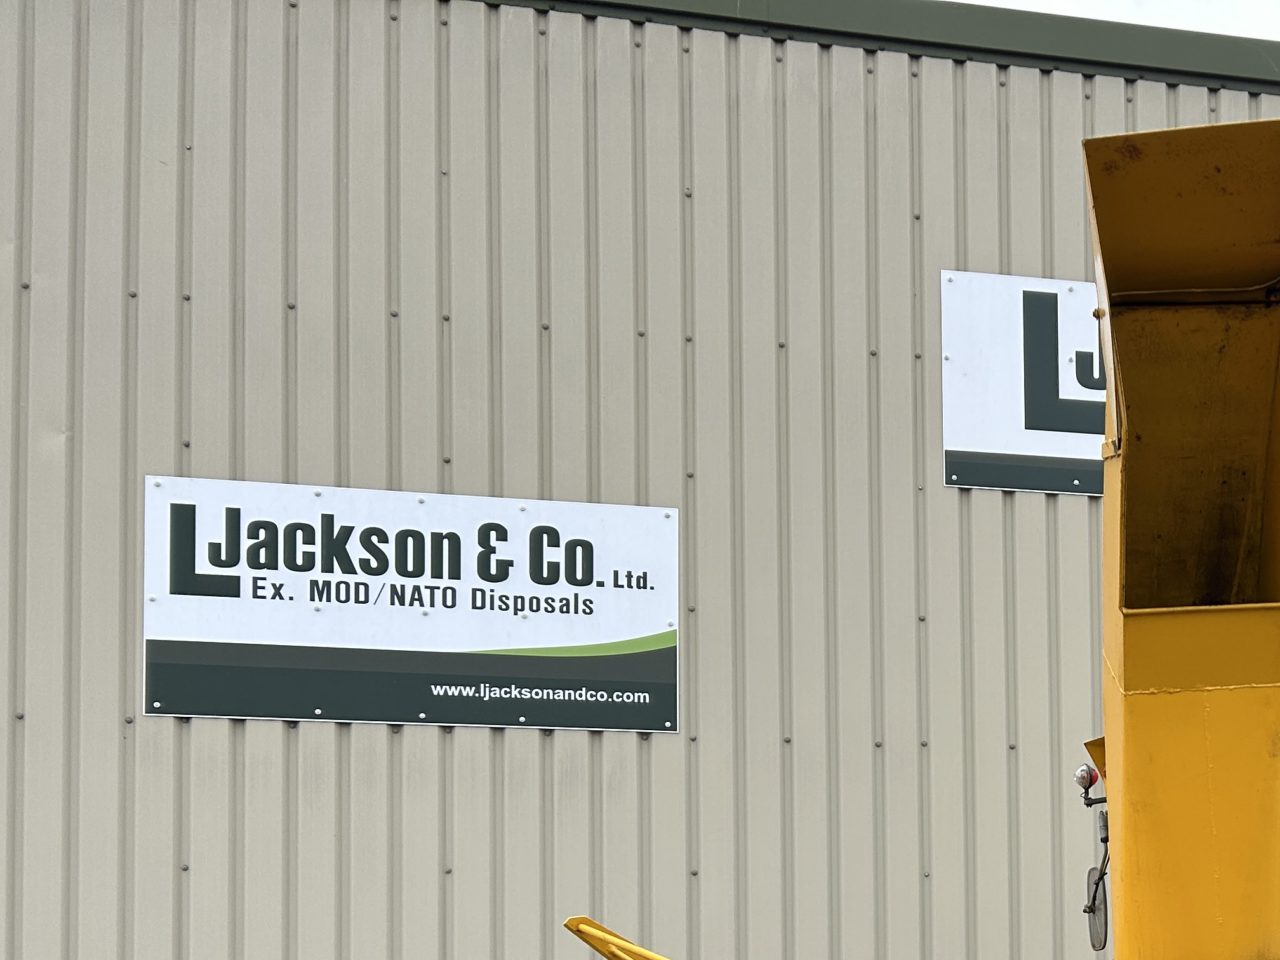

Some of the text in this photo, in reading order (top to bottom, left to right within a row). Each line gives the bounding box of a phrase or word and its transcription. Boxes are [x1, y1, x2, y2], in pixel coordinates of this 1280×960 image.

[476, 522, 514, 584] &
[528, 524, 605, 588] Co.
[613, 570, 655, 591] Ltd.
[251, 576, 594, 616] Ex. MOD/NATO Disposals
[430, 682, 650, 704] www.ljacksonandco.com
